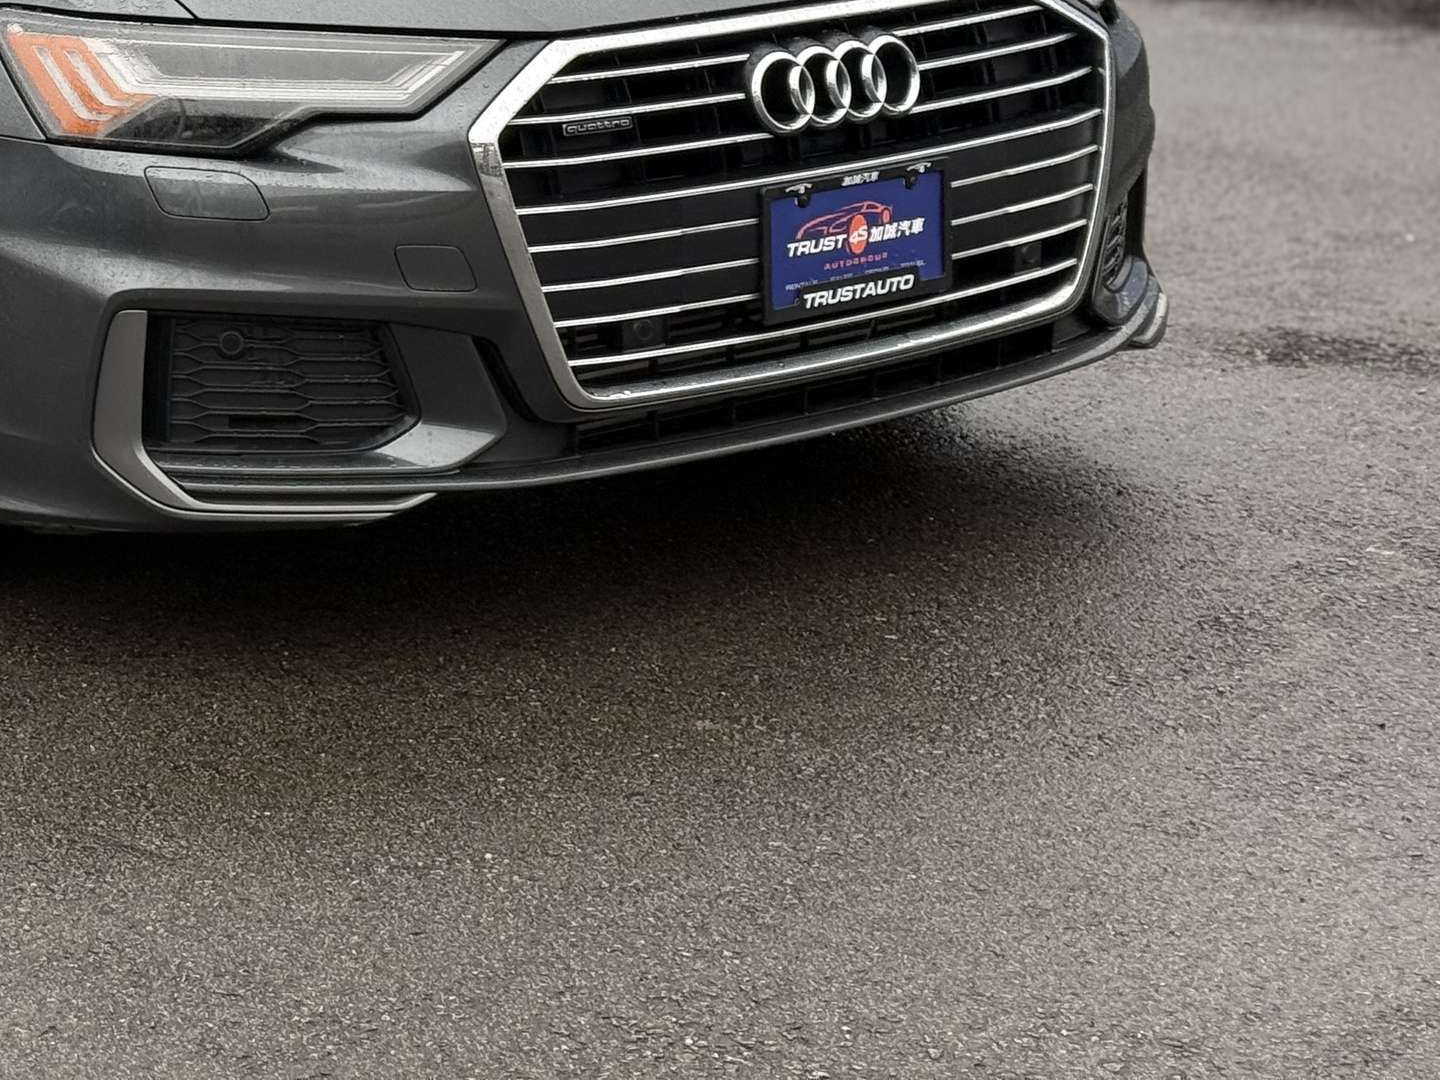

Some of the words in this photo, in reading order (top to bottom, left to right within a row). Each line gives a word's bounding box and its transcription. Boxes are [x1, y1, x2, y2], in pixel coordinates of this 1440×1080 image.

[567, 119, 630, 133] quattro
[787, 234, 847, 257] TRUST
[849, 225, 868, 244] 4S
[804, 274, 914, 308] TRUSTAUTO
